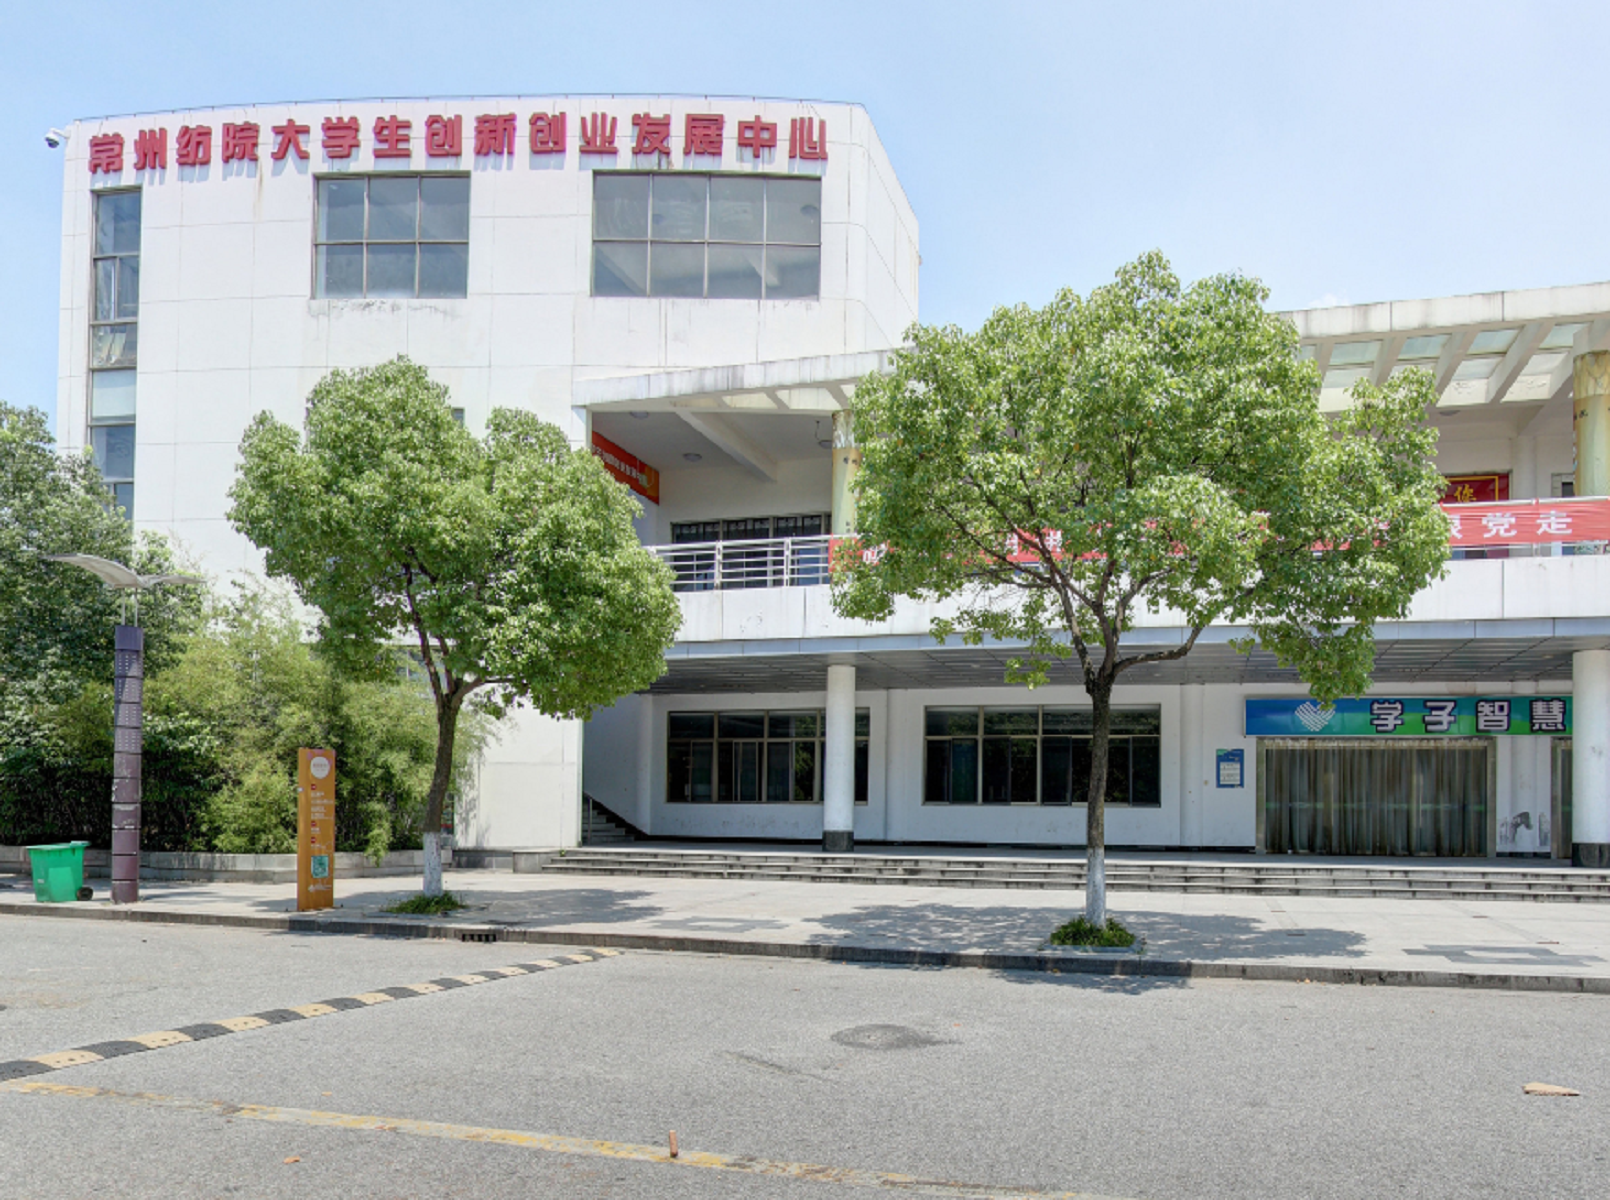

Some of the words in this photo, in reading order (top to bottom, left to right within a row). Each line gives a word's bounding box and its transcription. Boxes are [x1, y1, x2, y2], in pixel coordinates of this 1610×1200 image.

[88, 111, 829, 174] 常州纺院大学生创新创业发展中心
[1370, 698, 1567, 732] 学子智慧
